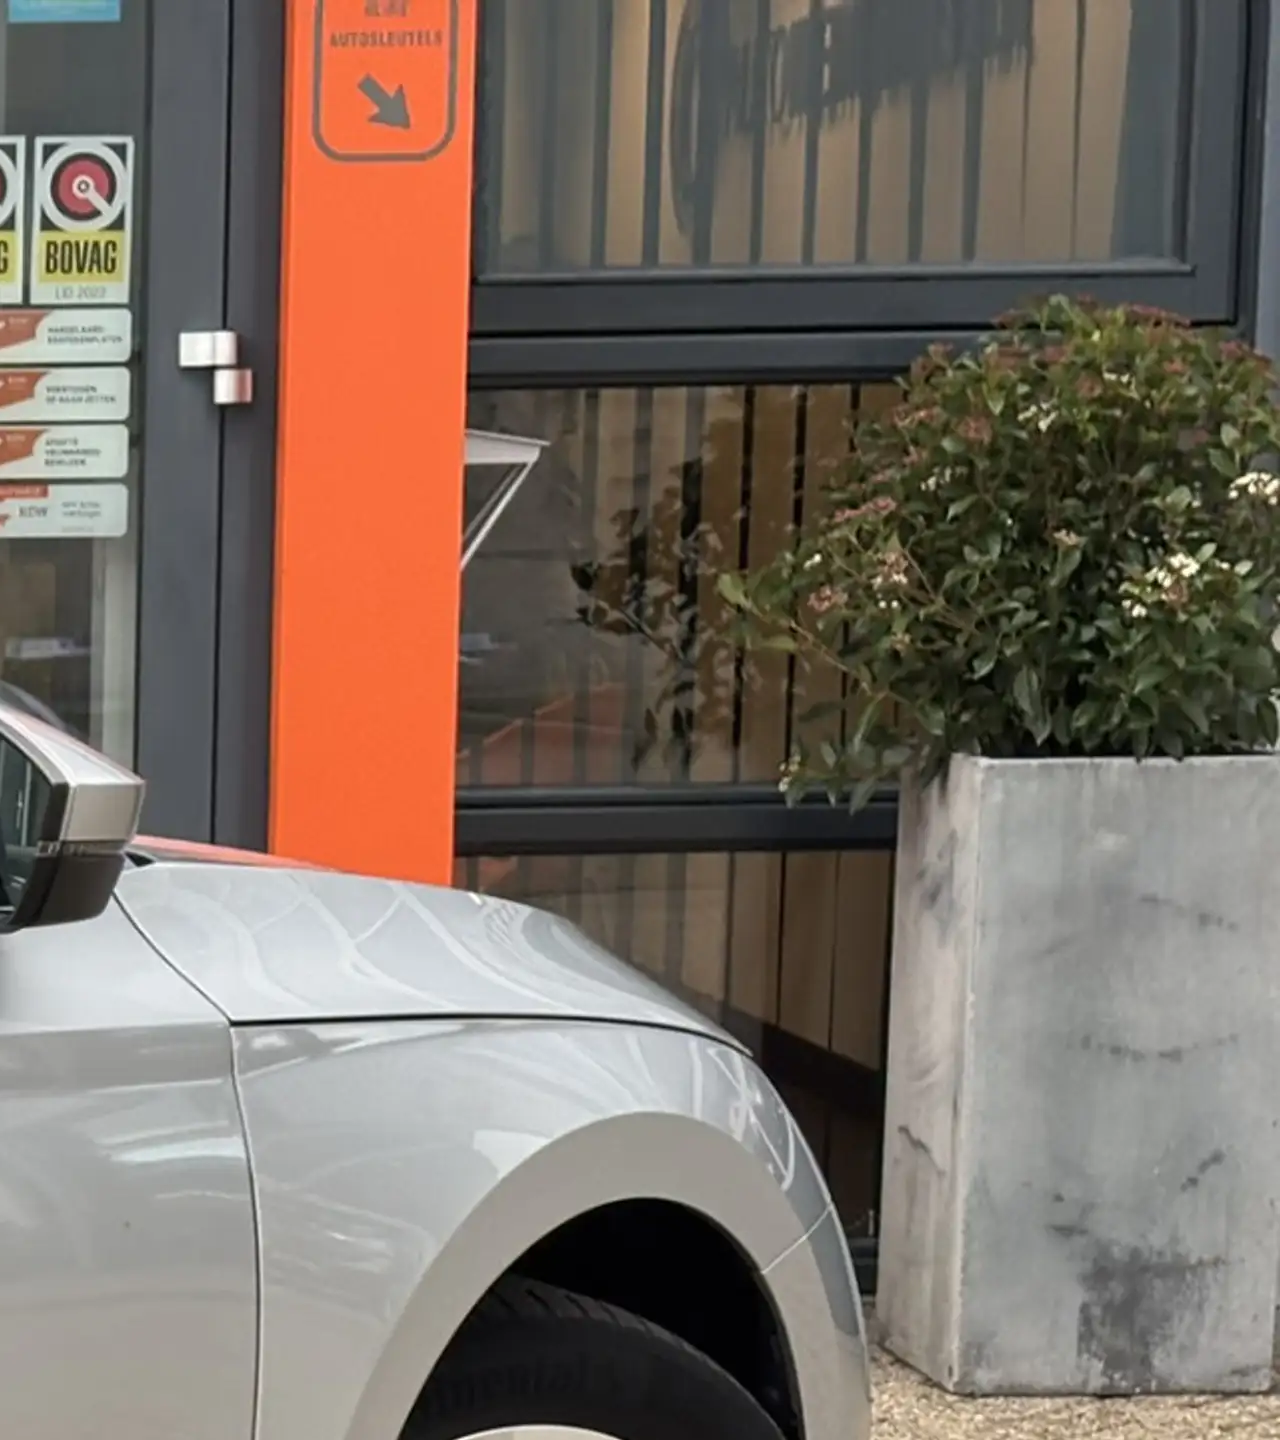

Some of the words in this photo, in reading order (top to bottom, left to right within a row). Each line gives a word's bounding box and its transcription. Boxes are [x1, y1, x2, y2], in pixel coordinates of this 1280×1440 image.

[330, 29, 443, 48] AUTOSLEUTELS
[45, 240, 117, 275] BOVAG
[55, 286, 72, 299] LID
